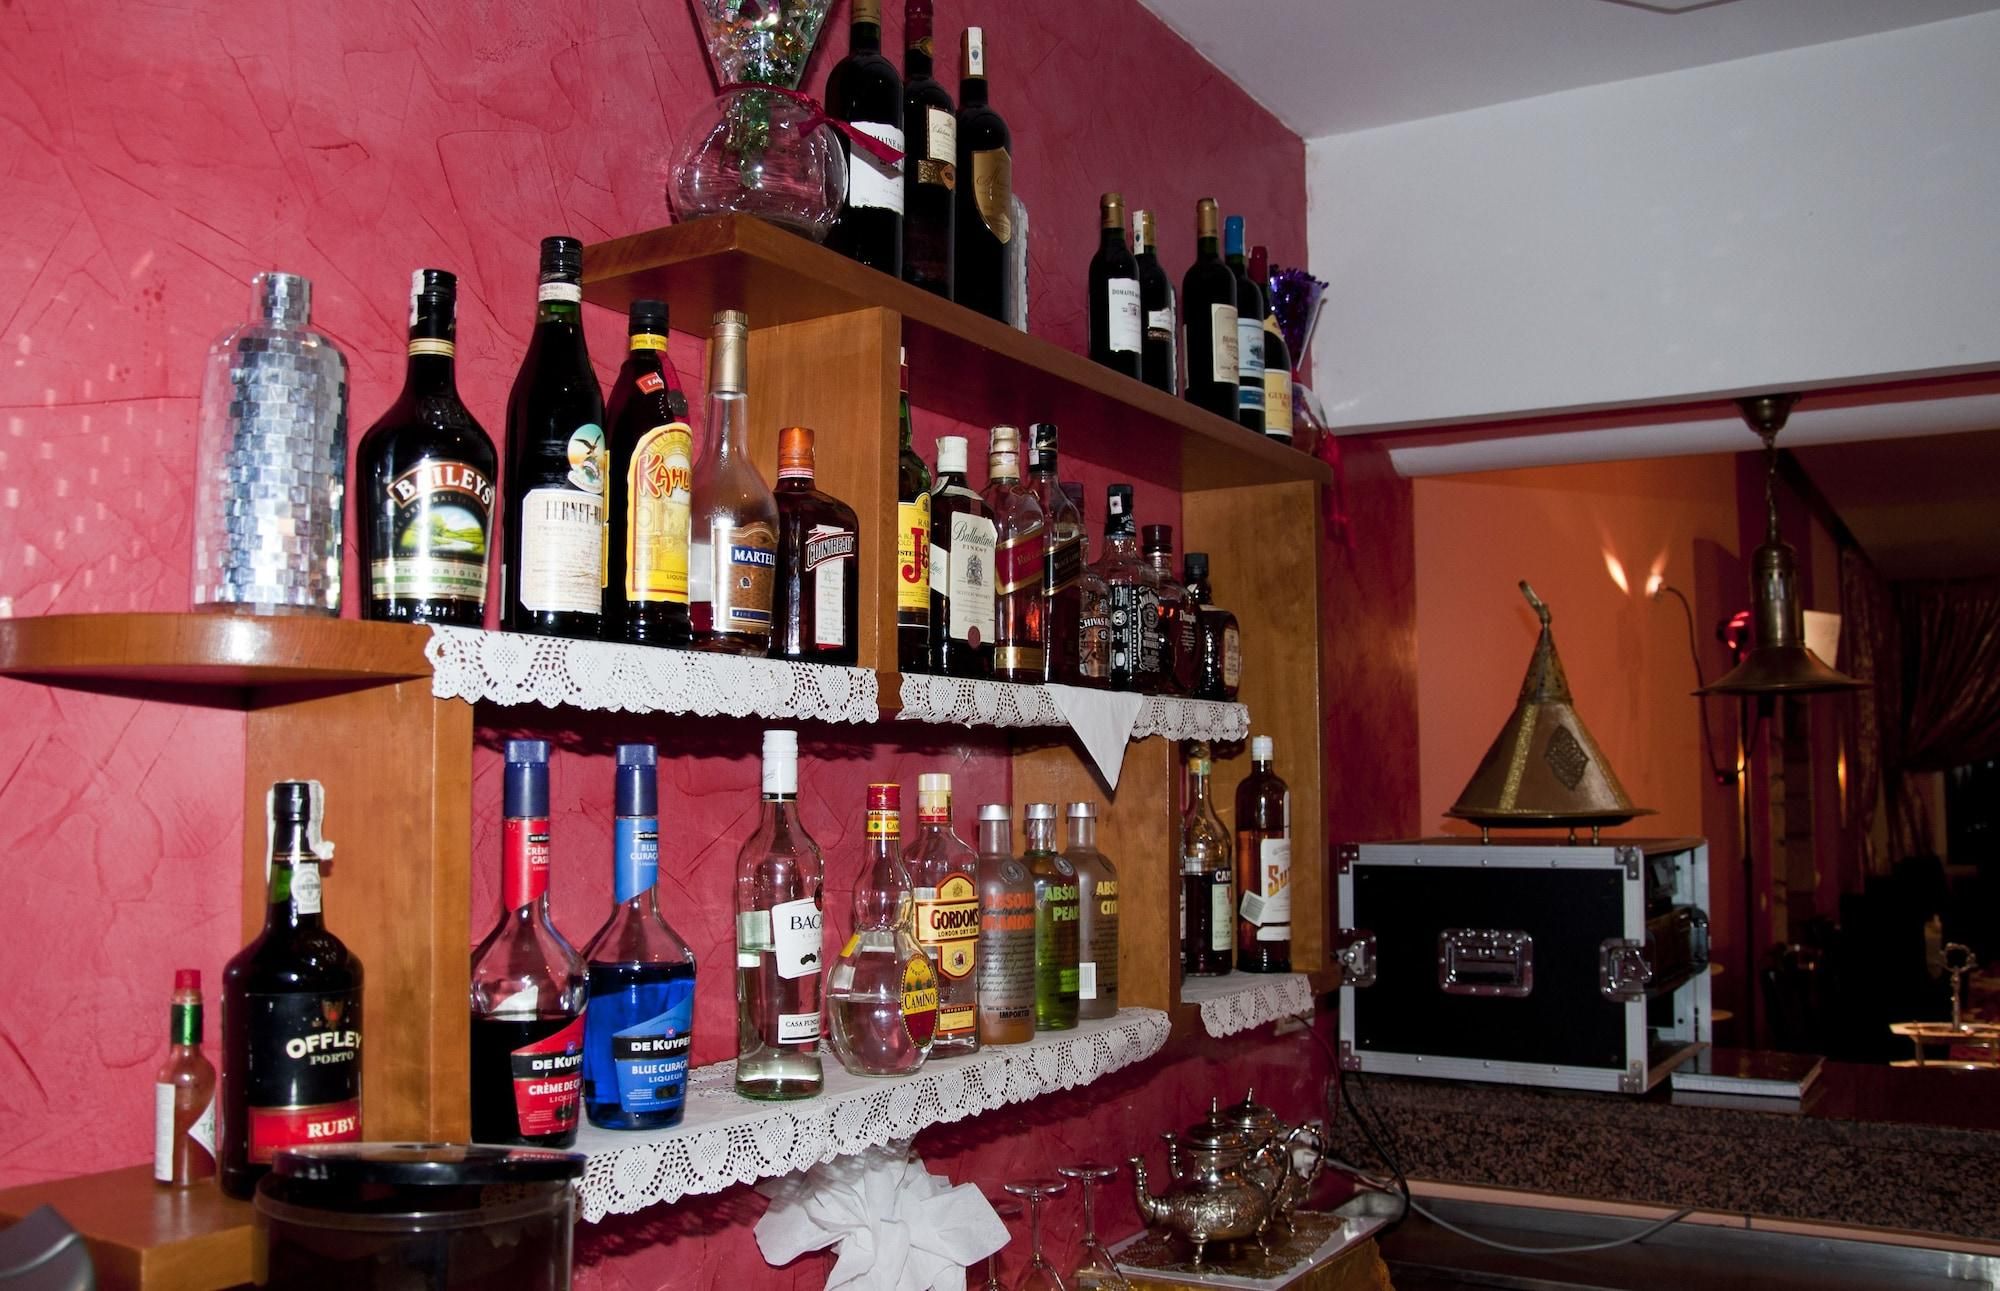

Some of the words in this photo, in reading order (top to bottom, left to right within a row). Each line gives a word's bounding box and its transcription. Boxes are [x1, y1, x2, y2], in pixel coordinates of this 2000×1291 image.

[395, 465, 492, 504] BILEYS
[734, 548, 775, 566] MARTELL
[807, 536, 854, 568] COINTREAU
[790, 912, 821, 931] BAC
[938, 930, 958, 938] LONDON
[286, 1030, 362, 1059] OFFLEY
[631, 1041, 651, 1052] DE
[310, 1051, 354, 1066] PORTO
[532, 1059, 553, 1070] DE
[632, 1064, 657, 1075] BLUE
[649, 1072, 683, 1083] LIQUEUR
[528, 1080, 564, 1096] CRÈME
[307, 1117, 356, 1139] RUBY
